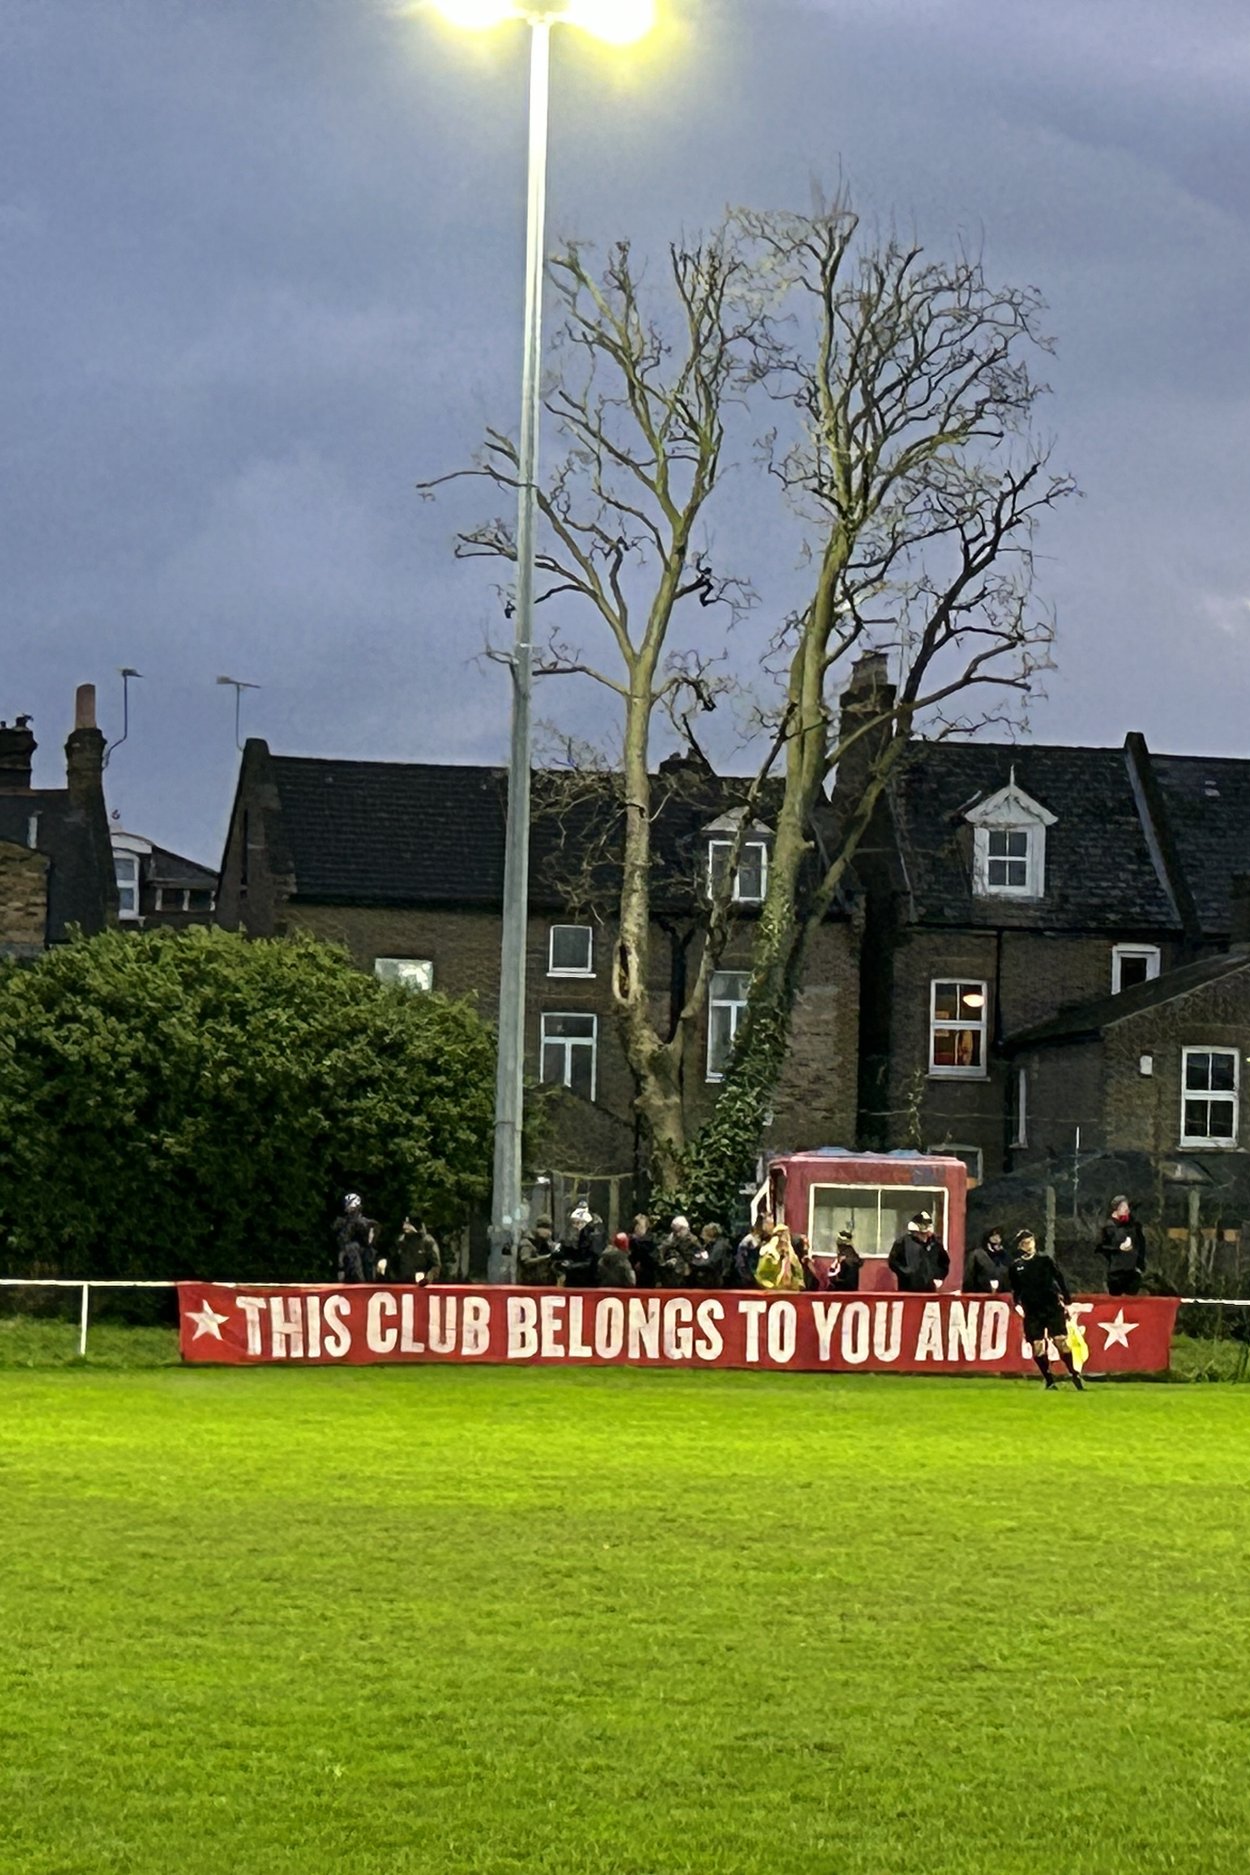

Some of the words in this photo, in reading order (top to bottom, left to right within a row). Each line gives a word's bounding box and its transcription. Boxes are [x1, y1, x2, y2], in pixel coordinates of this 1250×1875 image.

[235, 1295, 352, 1358] THIS
[366, 1291, 491, 1356] CLUB
[506, 1296, 725, 1361] BELONGS
[738, 1300, 797, 1364] TO
[811, 1301, 903, 1365] YOU
[914, 1300, 1011, 1362] AND
